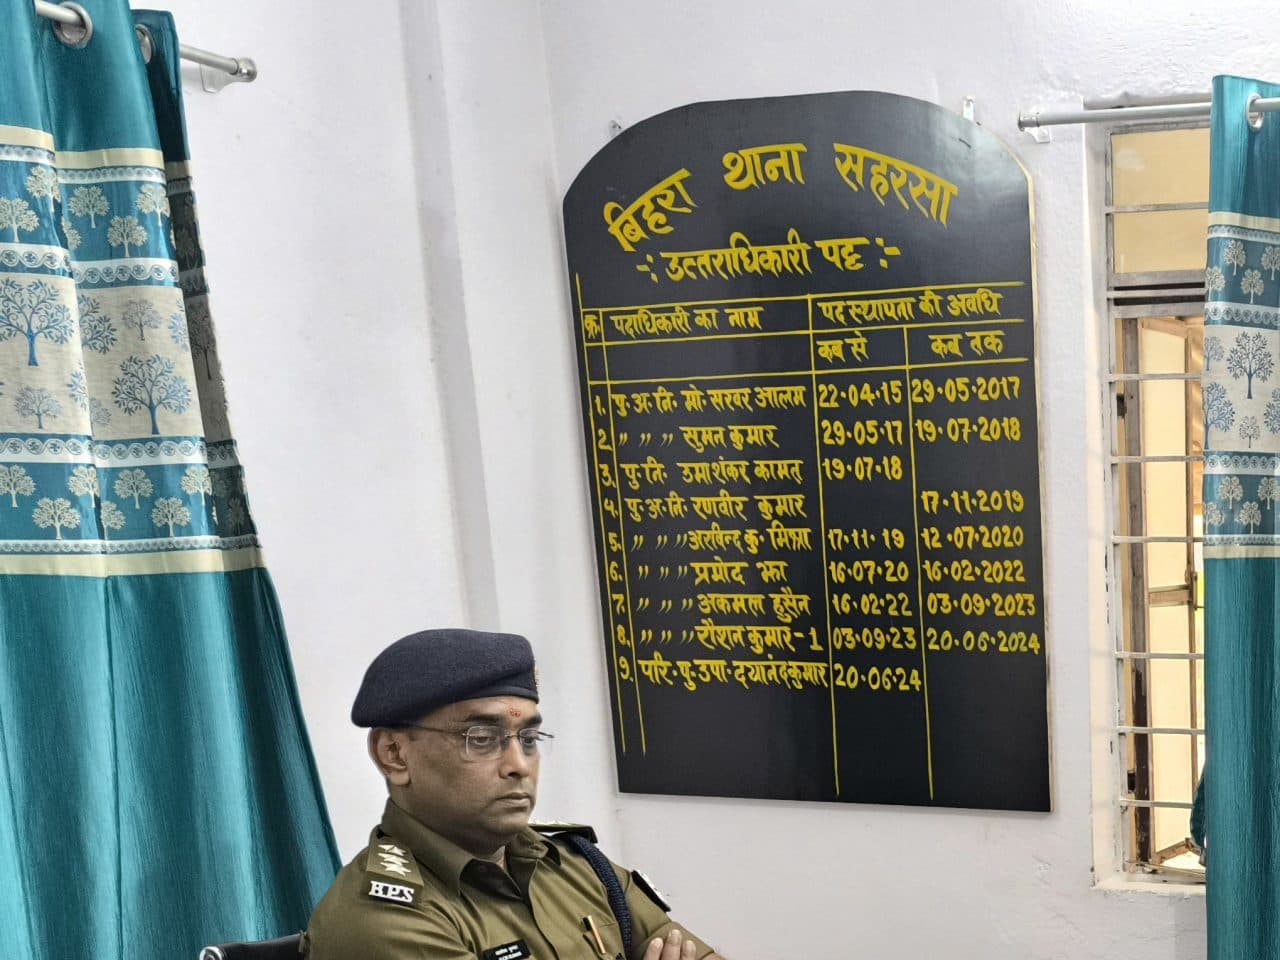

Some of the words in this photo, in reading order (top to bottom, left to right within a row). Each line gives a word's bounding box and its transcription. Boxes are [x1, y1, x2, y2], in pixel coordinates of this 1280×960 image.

[603, 168, 699, 252] बिहरा
[722, 143, 807, 191] थाना
[834, 144, 959, 224] सहरसा
[946, 287, 1002, 317] अवधि
[694, 308, 718, 329] का
[724, 306, 763, 329] नाम
[845, 332, 868, 360] से
[965, 330, 1004, 354] तक
[754, 385, 807, 408] आलम
[680, 426, 725, 454] सुमन
[728, 424, 778, 451] कुमार
[754, 493, 806, 521] कुमार
[689, 556, 749, 585] प्रमोद
[745, 624, 797, 655] कुमार
[368, 880, 415, 904] BPS
